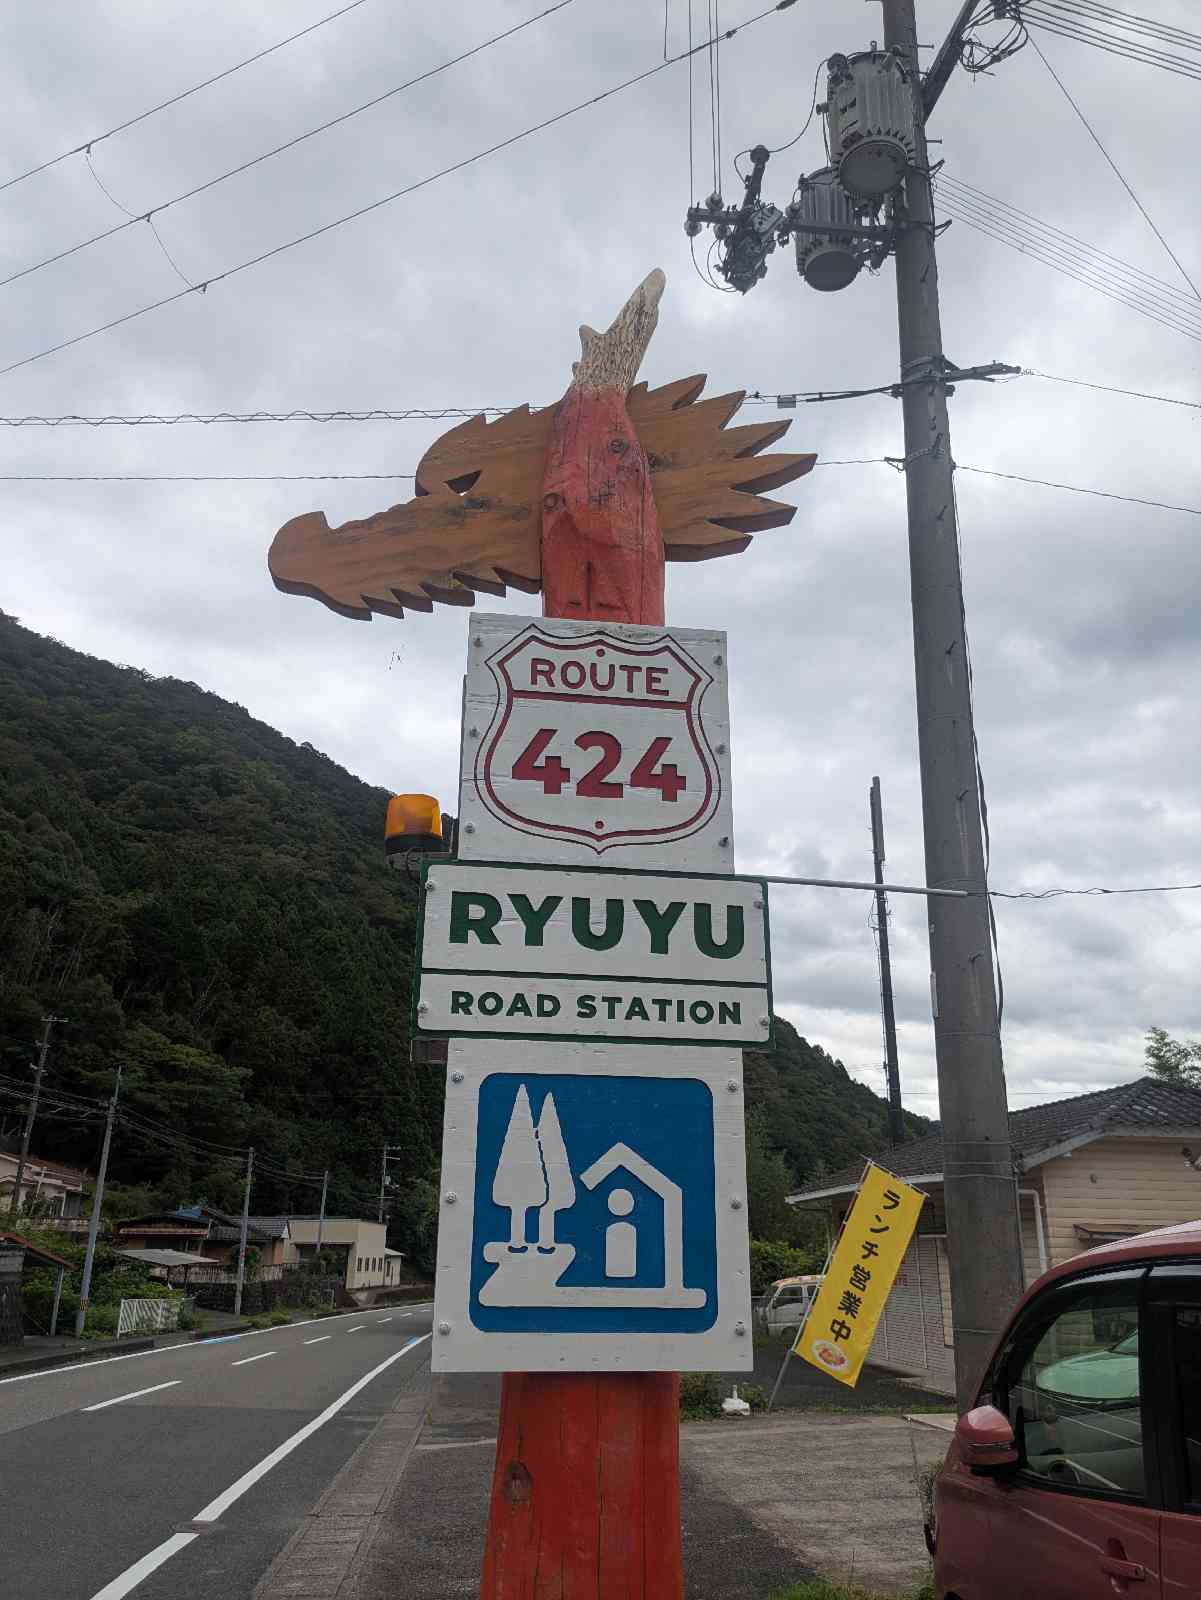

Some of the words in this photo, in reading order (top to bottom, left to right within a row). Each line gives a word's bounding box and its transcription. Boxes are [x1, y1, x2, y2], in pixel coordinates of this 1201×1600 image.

[530, 657, 670, 697] ROUTE
[511, 728, 687, 803] 424
[448, 890, 745, 960] RYUYU
[450, 990, 561, 1019] ROAD
[575, 993, 742, 1025] STATION
[830, 1189, 901, 1342] ランチ営業中
